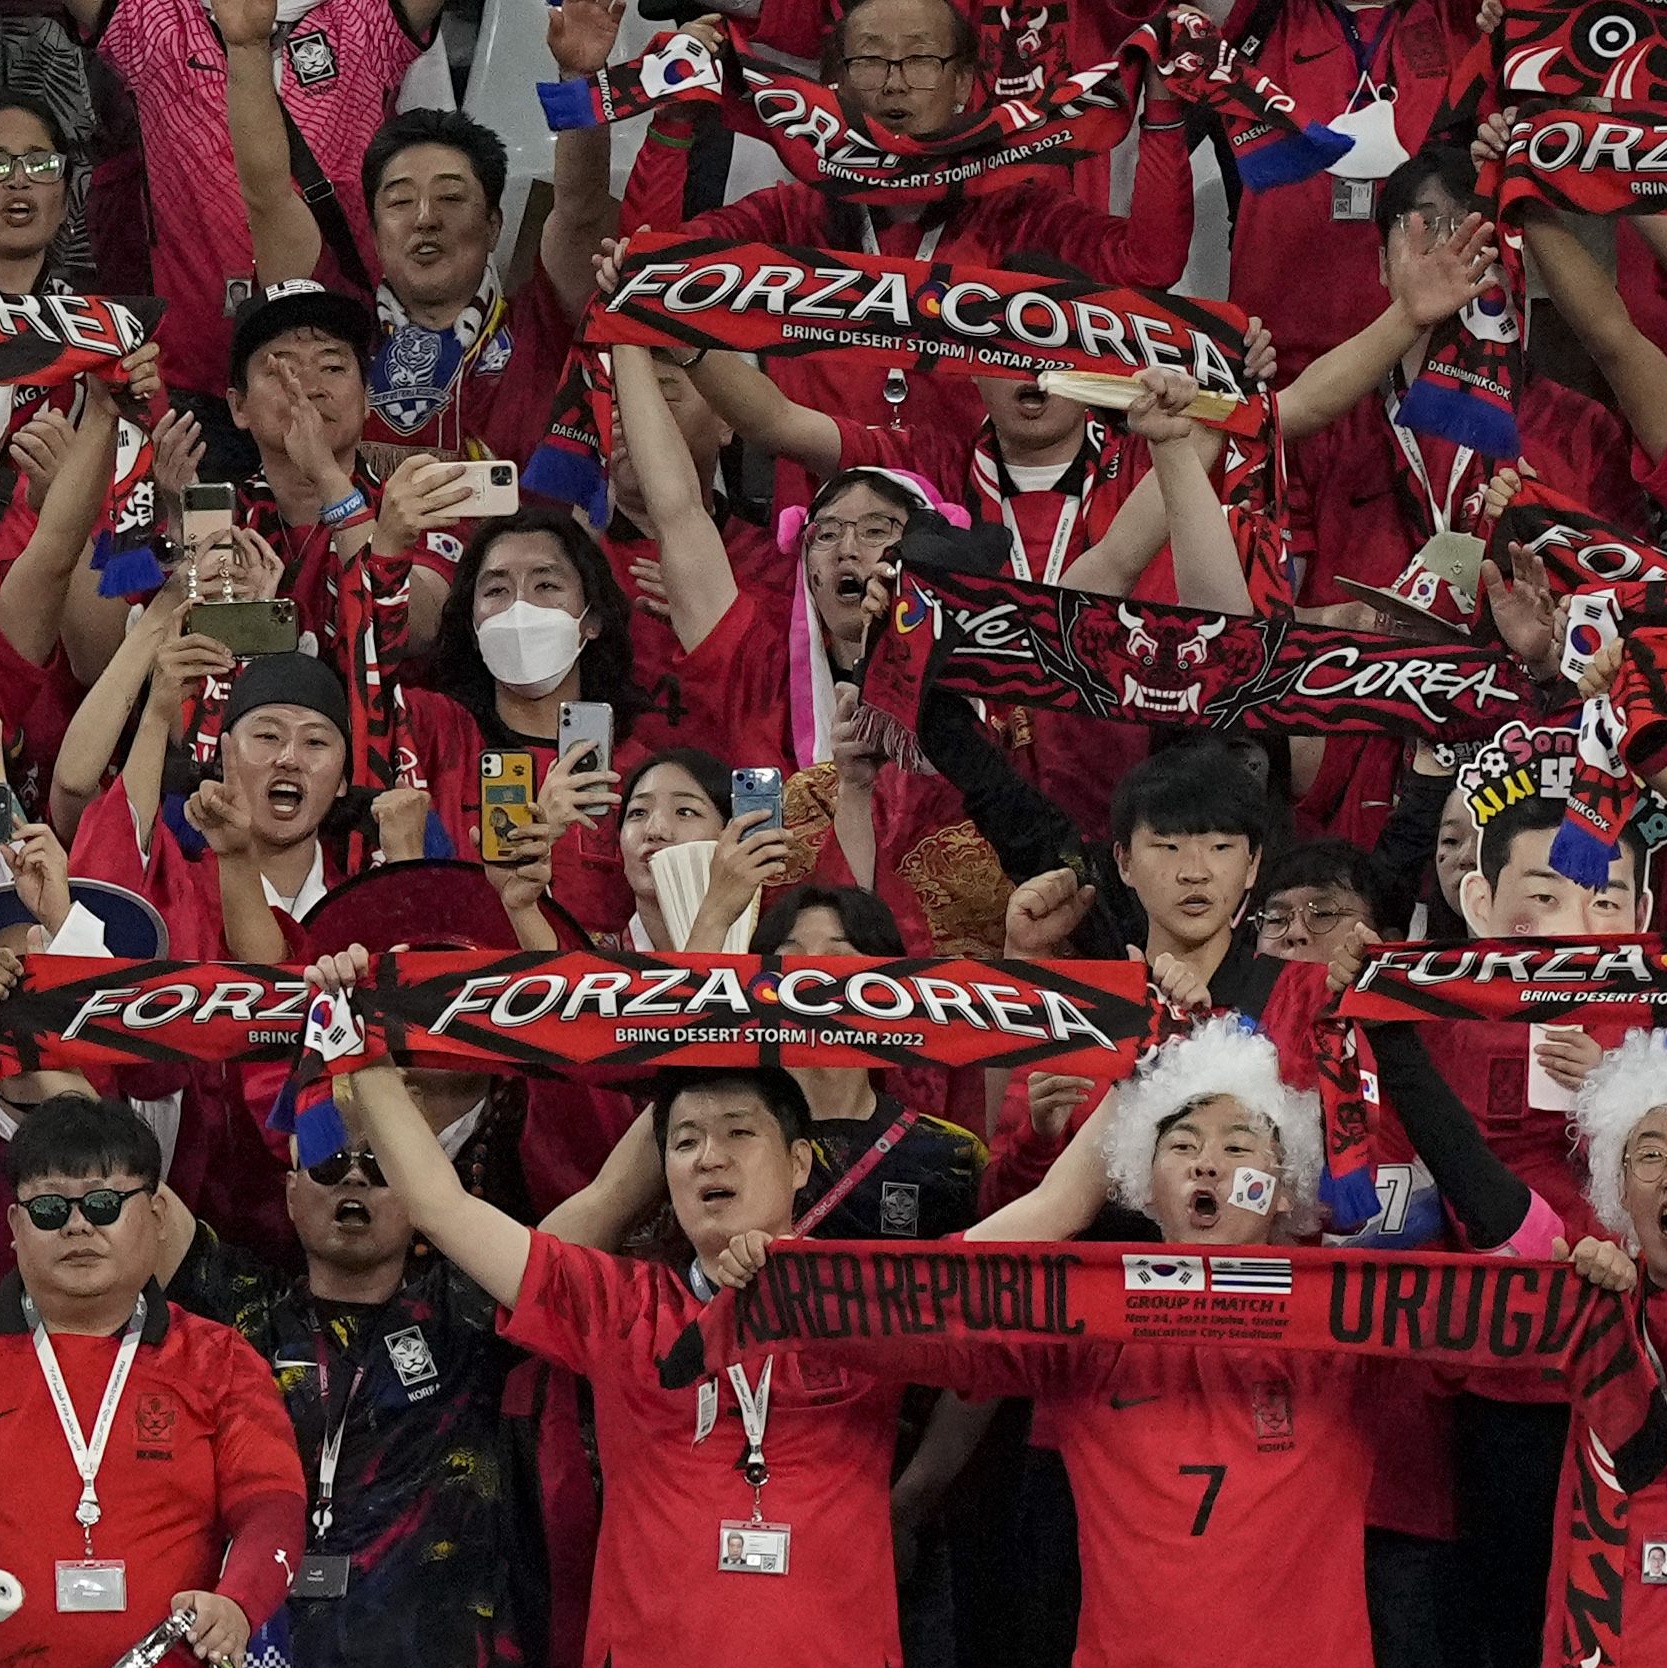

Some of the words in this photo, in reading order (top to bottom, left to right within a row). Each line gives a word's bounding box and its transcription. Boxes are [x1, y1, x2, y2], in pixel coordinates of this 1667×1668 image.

[934, 161, 982, 187] STORM
[988, 143, 1032, 171] QATAR
[1032, 130, 1073, 155] 2022
[606, 260, 914, 329] FORZA
[940, 280, 1248, 405] COREA
[781, 323, 836, 345] BRING
[838, 328, 904, 351] DESERT
[906, 337, 965, 359] STORM
[977, 346, 1034, 369] QATAR
[1295, 647, 1520, 723] COREA
[1502, 726, 1574, 766] Son
[60, 981, 307, 1041] FORZ
[429, 968, 750, 1037] FORZA
[776, 968, 1119, 1053] COREA
[1519, 988, 1573, 1002] BRING
[1575, 990, 1637, 1004] DESERT
[615, 1027, 671, 1043] BRING
[673, 1028, 741, 1044] DESERT
[743, 1029, 807, 1046] STORM
[819, 1030, 878, 1047] QATAR
[881, 1030, 925, 1047] 2022
[873, 1252, 1086, 1336] REPUBLIC
[1125, 1295, 1190, 1310] GROUP
[1210, 1297, 1273, 1313] MATCH
[1178, 1465, 1227, 1537] 7
